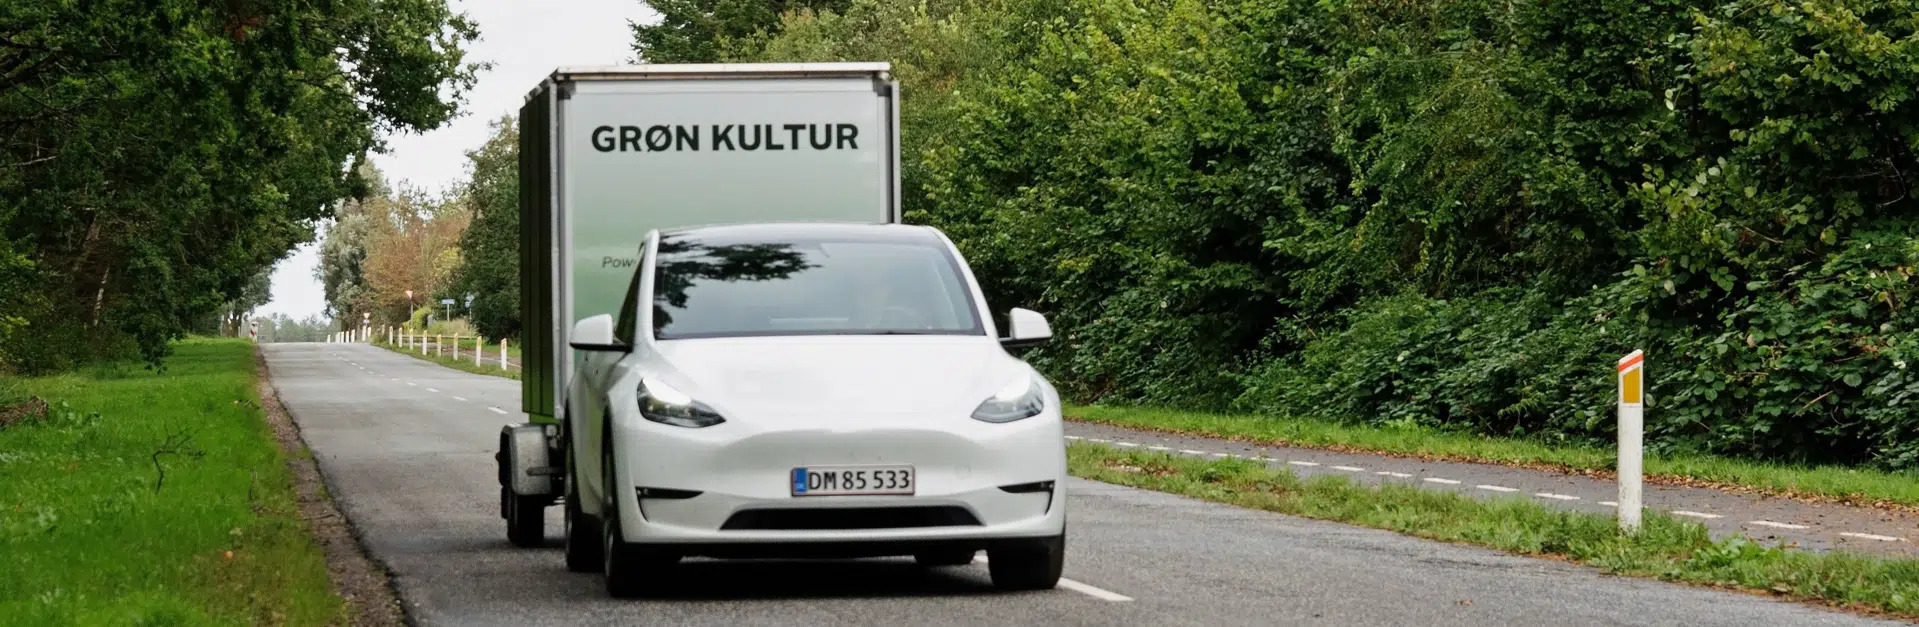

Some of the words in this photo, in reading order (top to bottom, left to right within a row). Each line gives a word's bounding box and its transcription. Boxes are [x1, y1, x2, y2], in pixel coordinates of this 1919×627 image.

[591, 125, 700, 153] GRØN
[711, 123, 859, 151] KULTUR
[602, 256, 637, 268] Pow
[808, 472, 837, 490] DM
[842, 471, 867, 490] 85
[873, 470, 910, 489] 533
